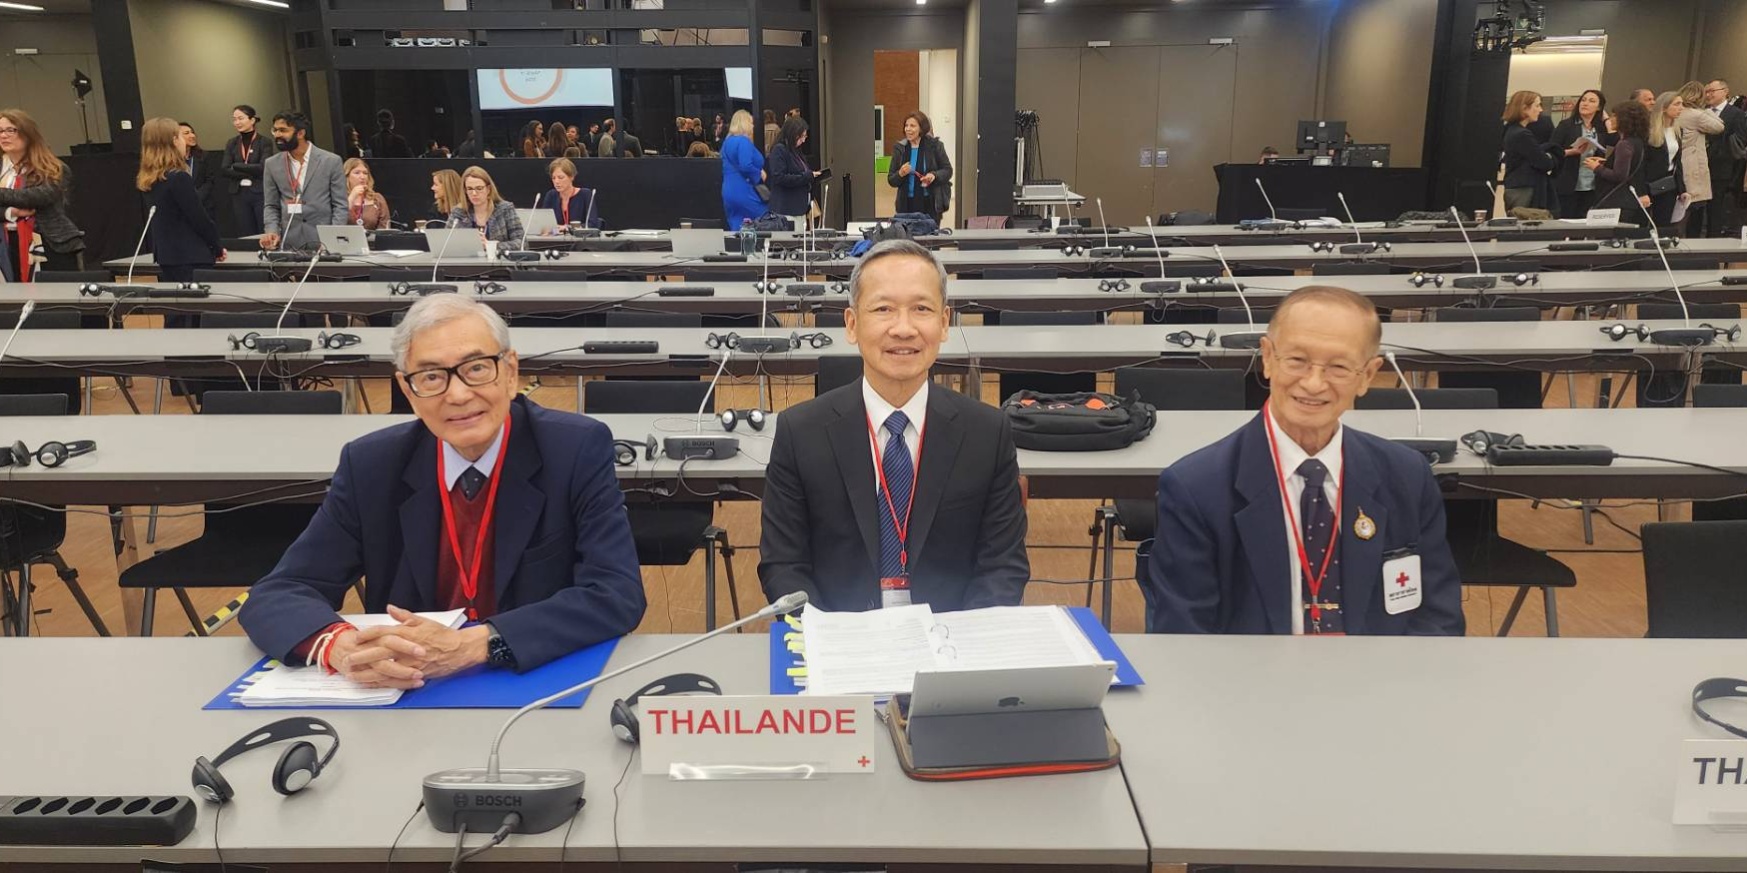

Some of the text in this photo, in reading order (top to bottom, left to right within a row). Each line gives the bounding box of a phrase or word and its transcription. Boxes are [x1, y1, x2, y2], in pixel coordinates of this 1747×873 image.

[647, 709, 857, 735] THAILANDE
[1693, 757, 1747, 785] TH
[475, 795, 522, 807] BOSCH
